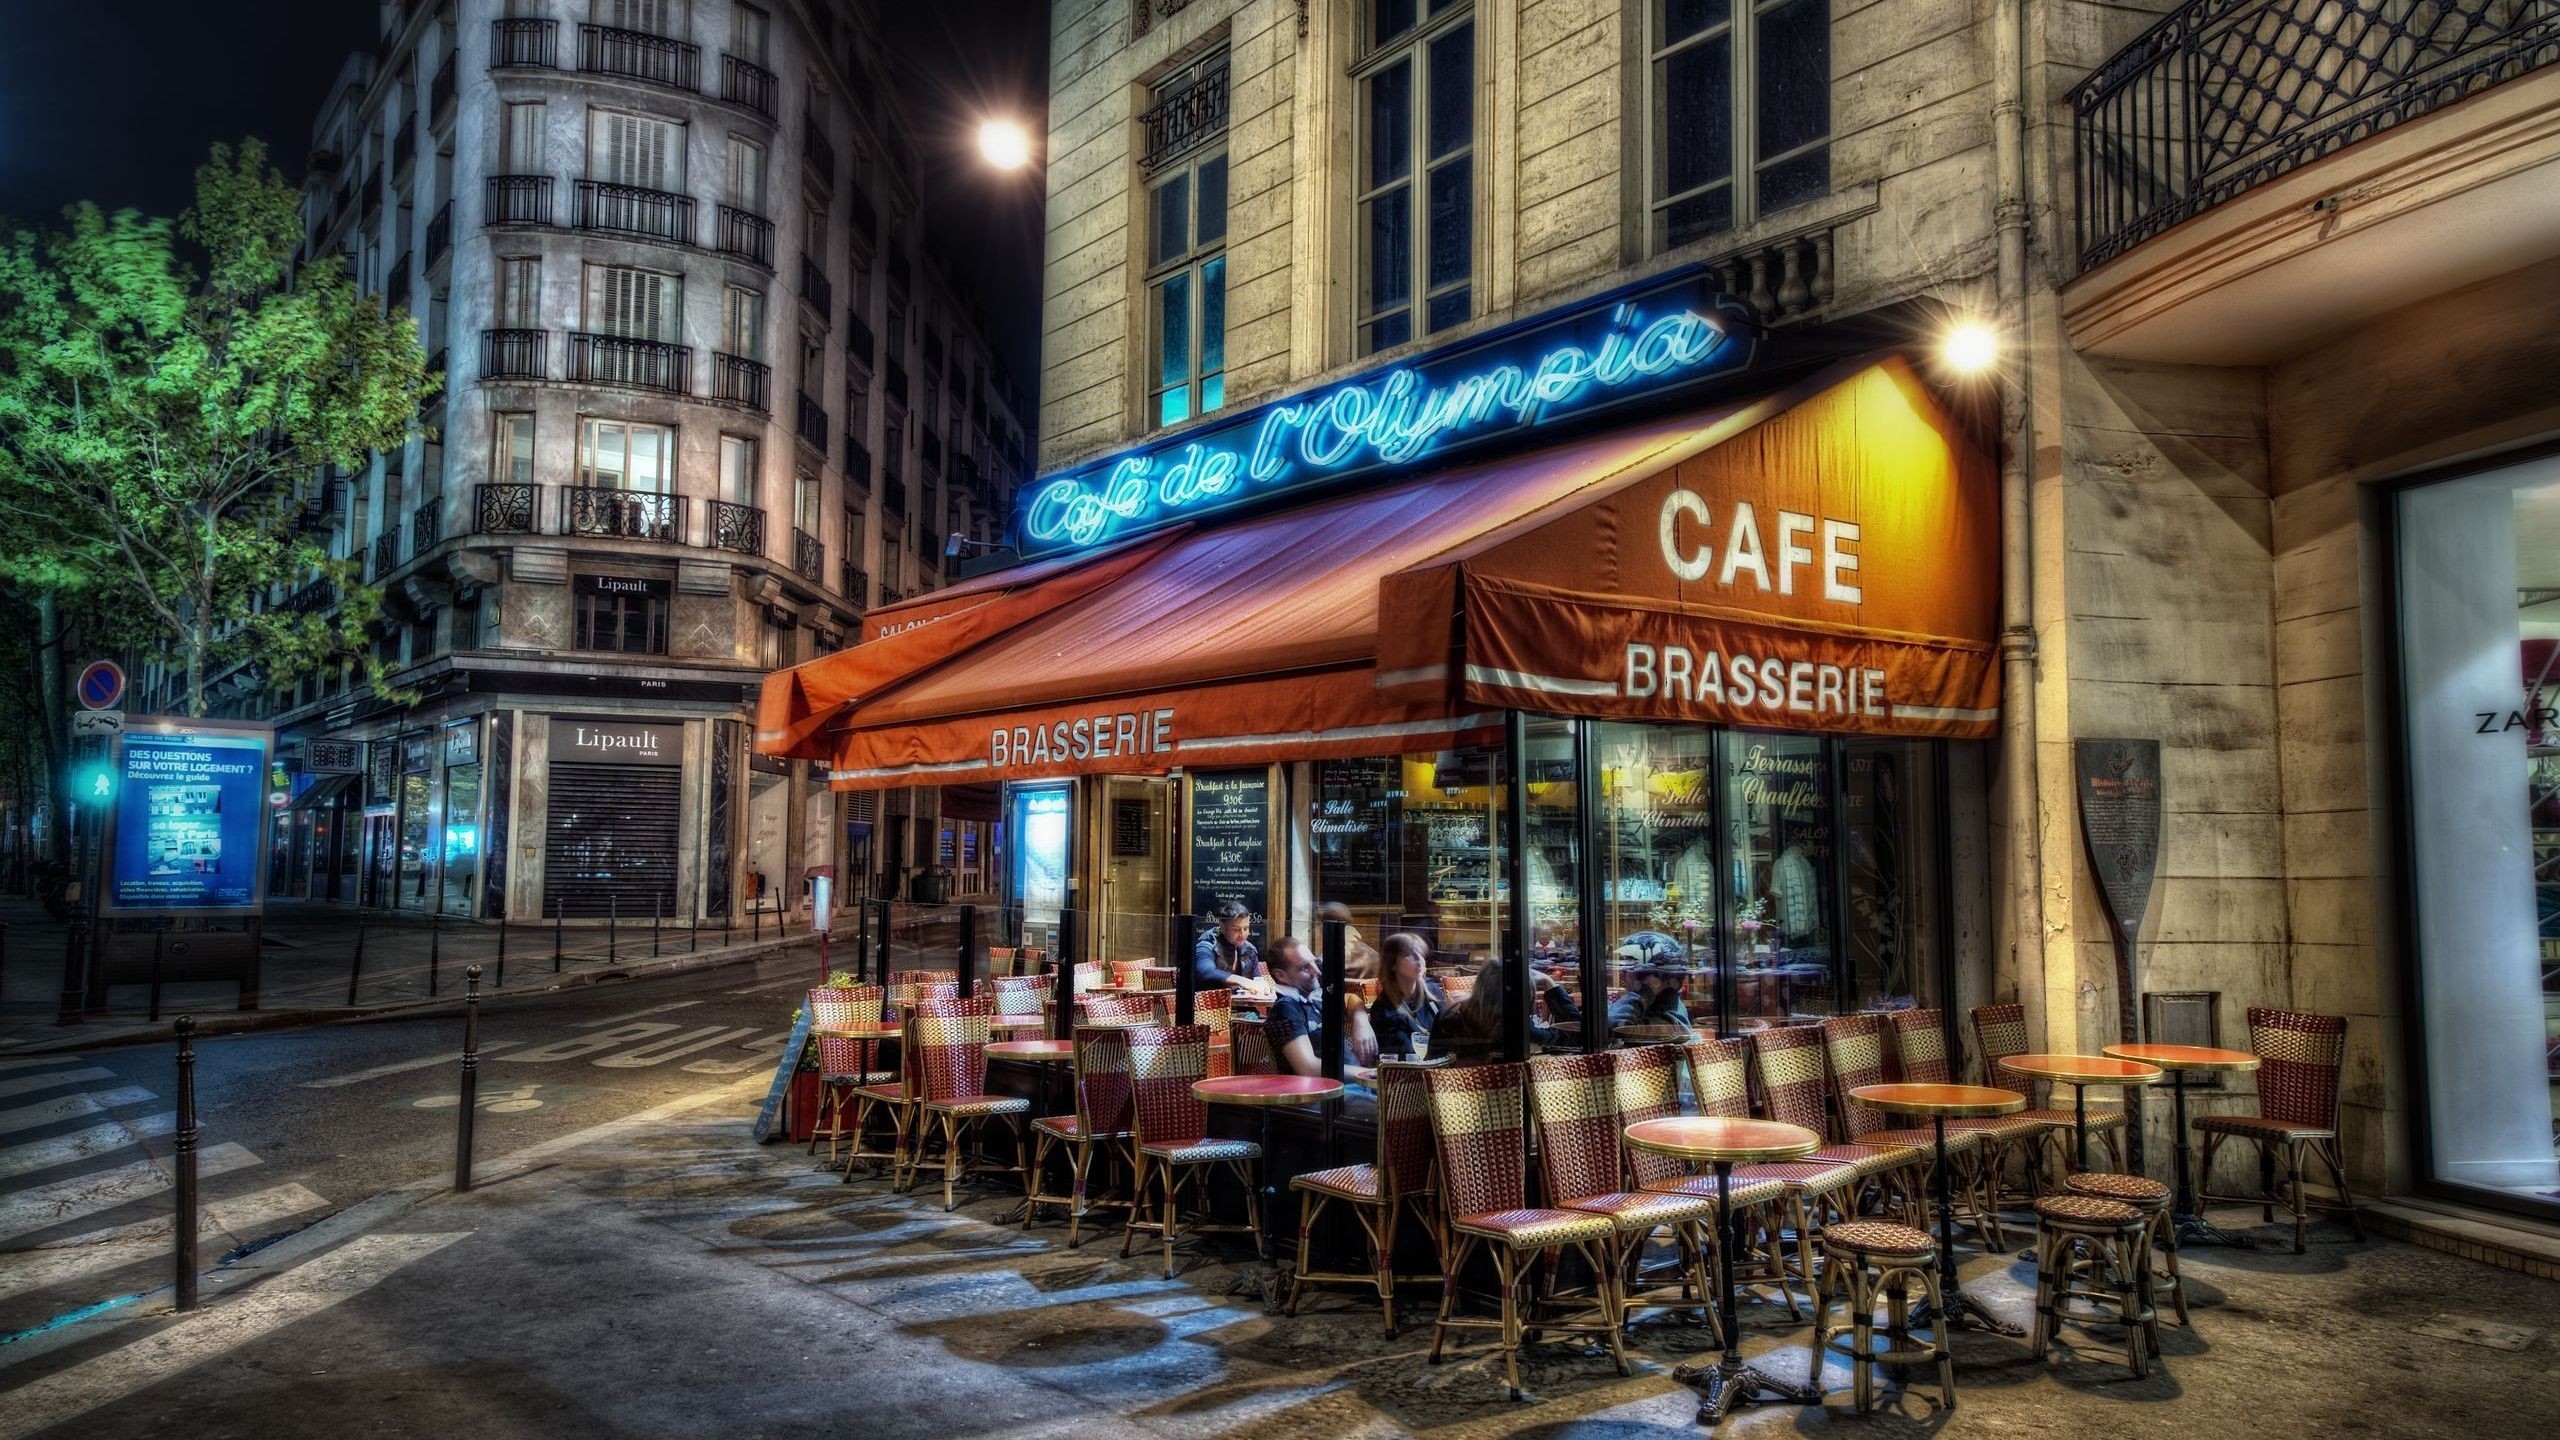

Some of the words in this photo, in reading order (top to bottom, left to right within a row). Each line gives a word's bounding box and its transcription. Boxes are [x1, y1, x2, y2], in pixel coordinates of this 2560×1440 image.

[1159, 443, 1240, 506] de
[1658, 488, 1863, 605] CAFE
[597, 576, 649, 593] Lipault
[641, 680, 667, 688] PARIS
[1625, 642, 1887, 717] BRASSERIE
[575, 727, 659, 751] Lipault
[991, 708, 1175, 768] BRASSERIE
[129, 750, 151, 759] DES
[152, 751, 212, 762] QUESTIONS
[128, 761, 151, 770] SUR
[152, 761, 189, 771] VOTRE
[190, 763, 246, 774] LOGEMENT
[247, 765, 254, 774] ?
[128, 771, 174, 780] Découvrez
[175, 772, 185, 780] le
[185, 773, 210, 782] guide
[1661, 786, 1706, 806] Salle
[1324, 800, 1354, 815] Salle
[1311, 818, 1369, 834] Climatisée
[1641, 810, 1711, 828] Climatis
[187, 829, 218, 839] Paris
[493, 1022, 787, 1075] BUS
